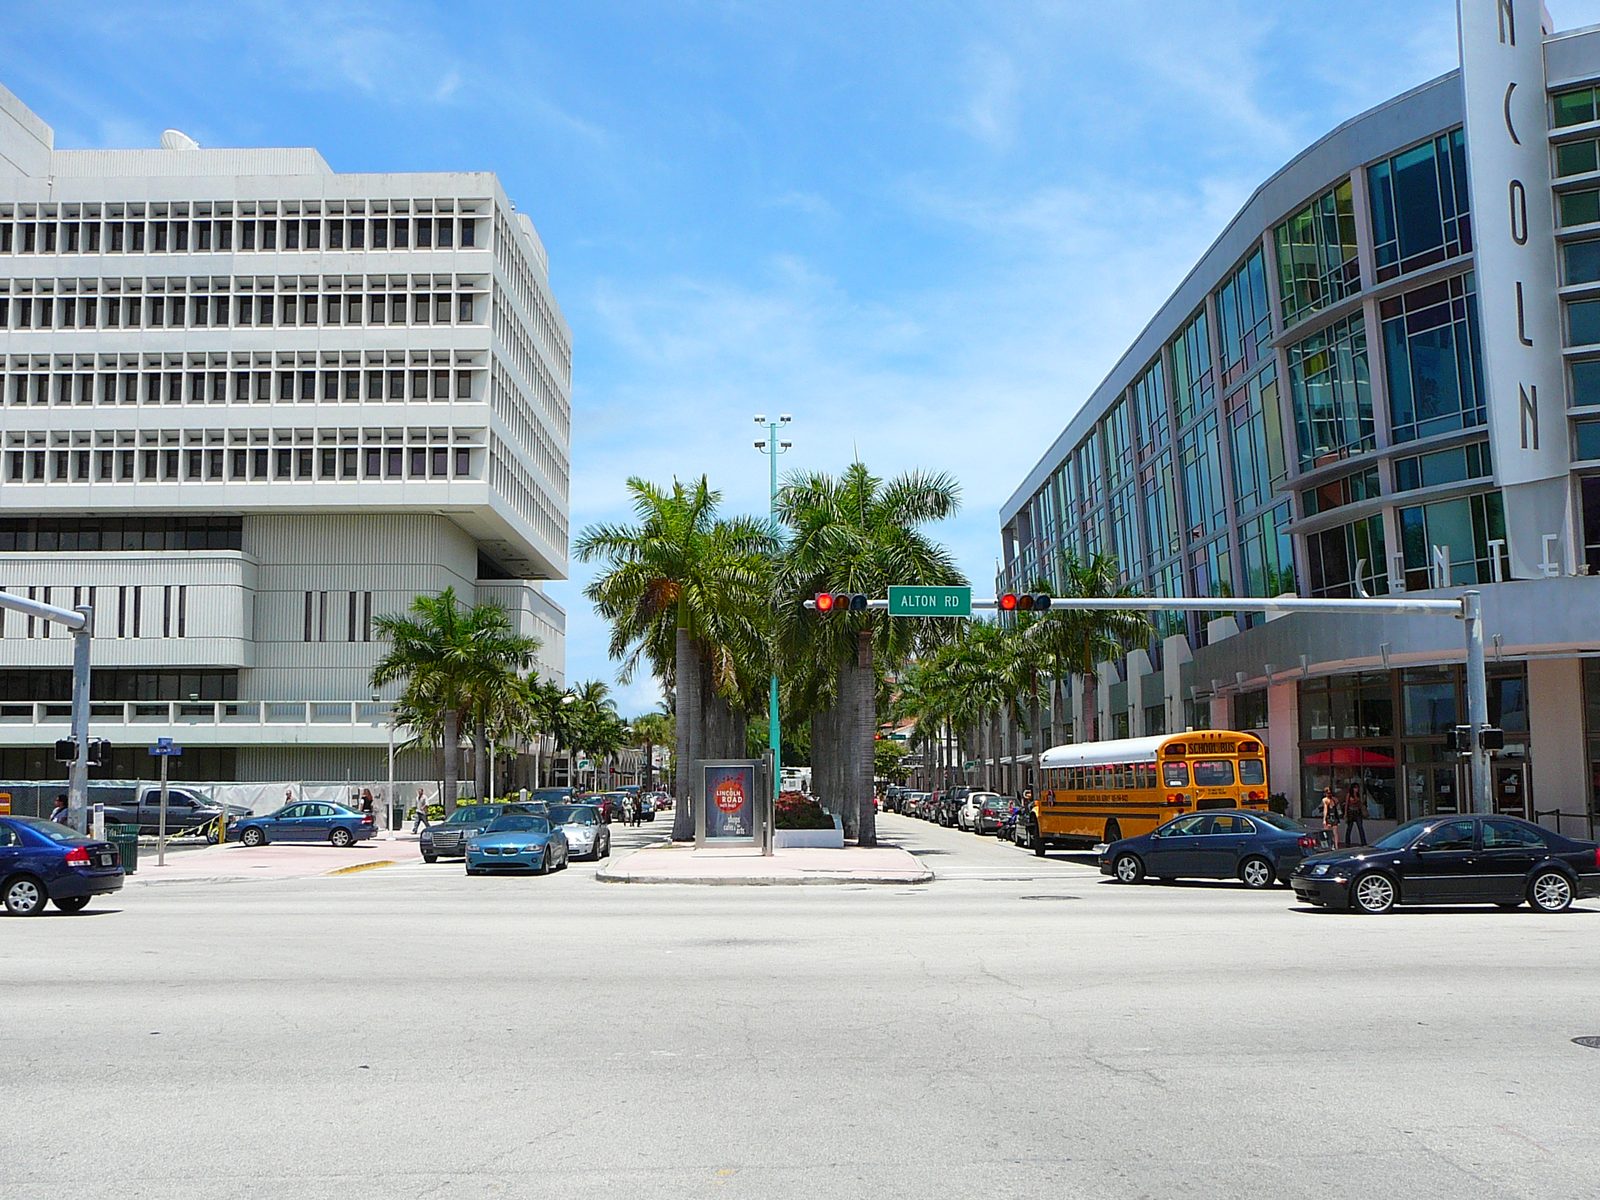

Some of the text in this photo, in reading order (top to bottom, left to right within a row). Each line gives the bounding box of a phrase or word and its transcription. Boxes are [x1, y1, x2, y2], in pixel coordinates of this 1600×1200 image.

[901, 595, 959, 607] ALTON RD
[1188, 741, 1236, 754] SCHOOL BUS
